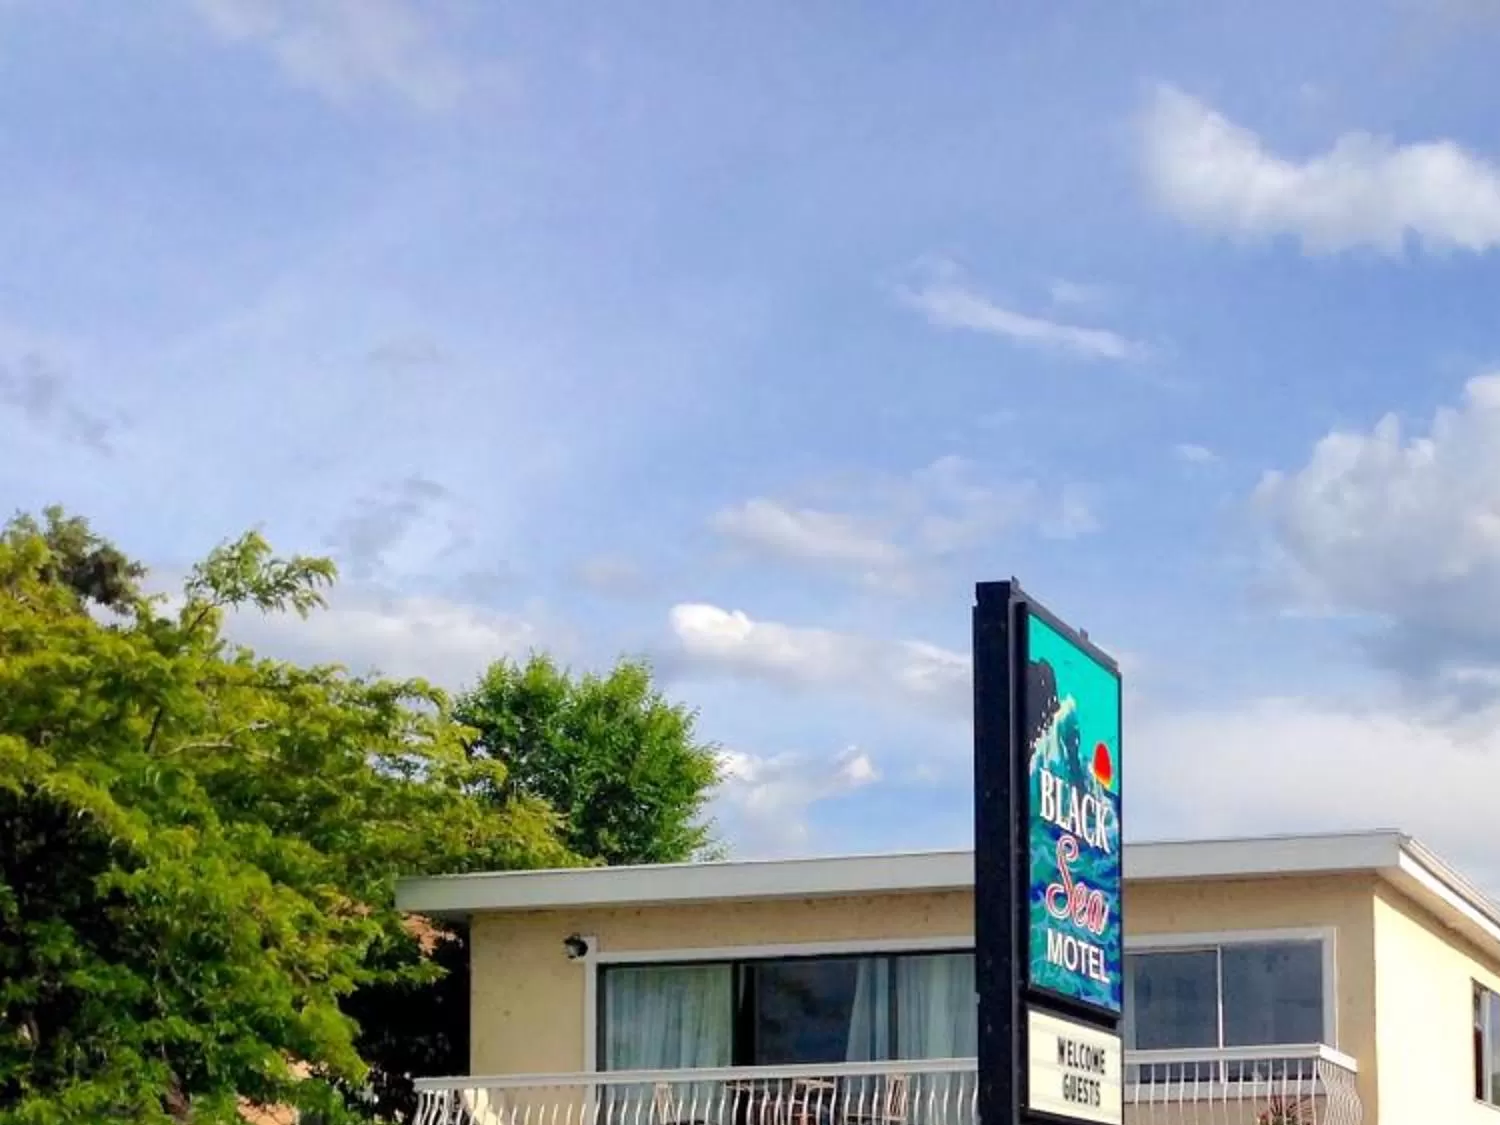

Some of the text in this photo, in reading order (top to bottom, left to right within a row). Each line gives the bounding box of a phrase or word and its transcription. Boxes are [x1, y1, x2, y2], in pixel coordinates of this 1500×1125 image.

[1040, 768, 1110, 853] BLACK
[1046, 835, 1109, 935] Sea
[1047, 927, 1110, 984] MOTEL
[1057, 1036, 1105, 1076] WELCOME
[1063, 1073, 1100, 1106] GUESTS
